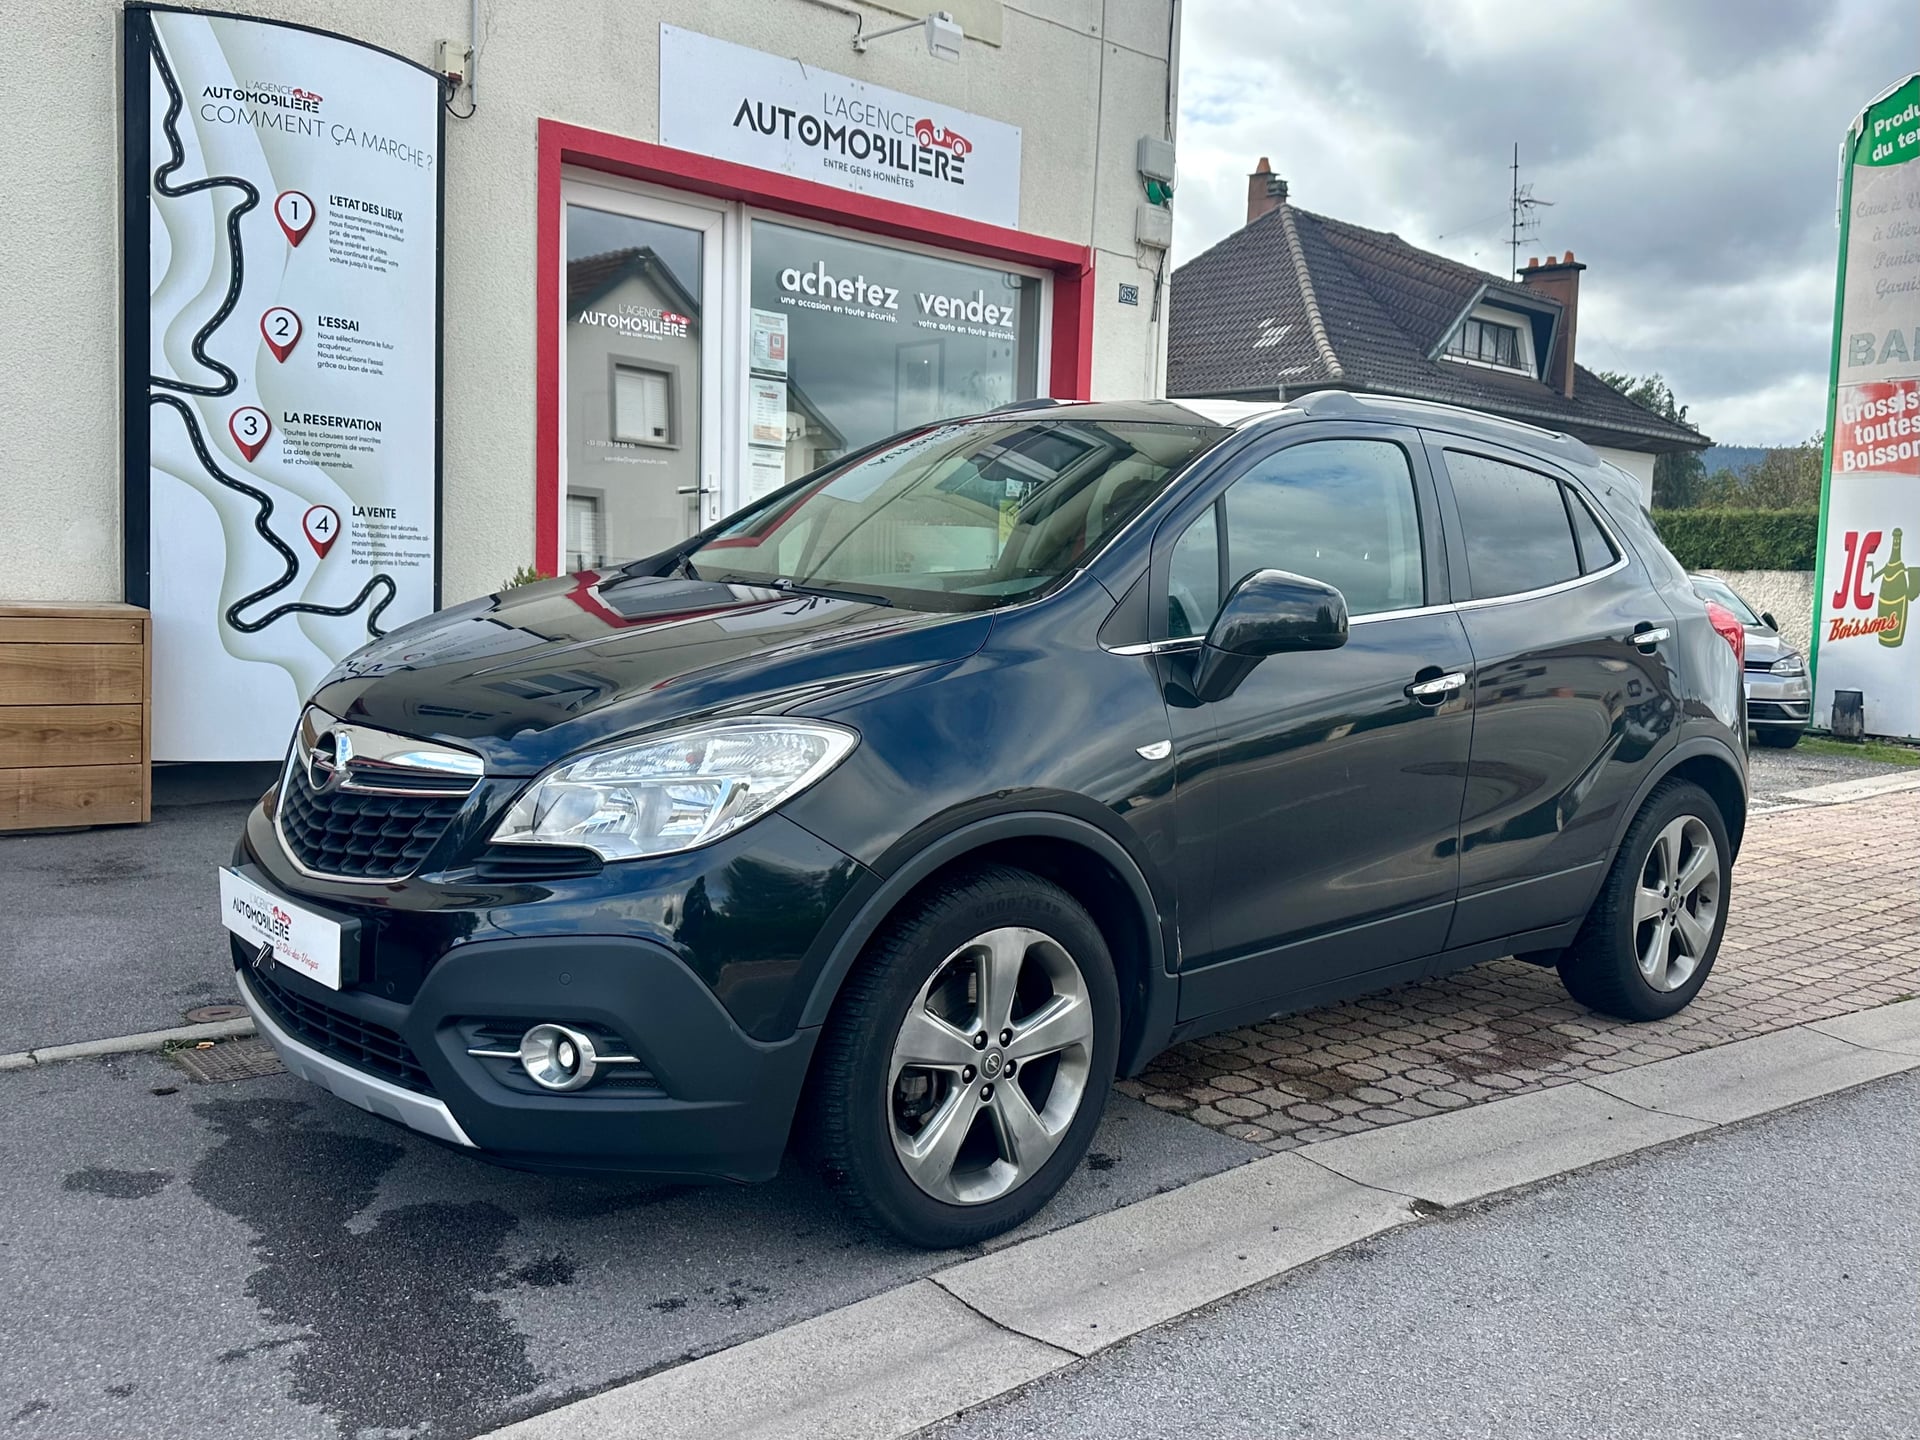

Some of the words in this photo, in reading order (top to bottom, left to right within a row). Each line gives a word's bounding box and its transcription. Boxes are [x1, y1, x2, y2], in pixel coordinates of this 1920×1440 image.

[246, 80, 293, 95] L'AGENCE
[823, 92, 915, 138] L'AGENCE
[201, 104, 325, 136] COMMENT
[330, 124, 357, 146] ÇA
[361, 132, 424, 168] MARCHE
[1872, 142, 1893, 162] du
[823, 159, 848, 173] ENTRE
[850, 165, 871, 178] GENS
[873, 168, 914, 188] HONNÊTES
[291, 201, 298, 220] 1
[329, 211, 343, 219] Nous
[330, 195, 360, 210] L'ETAT
[362, 202, 379, 215] DES
[381, 207, 402, 222] LIEUX
[781, 261, 899, 309] achetez
[1122, 287, 1137, 302] 652
[619, 304, 662, 319] L'AGENCE
[781, 296, 795, 306] une
[798, 299, 830, 311] occasion
[833, 305, 843, 313] en
[845, 305, 864, 318] toute
[867, 309, 897, 323] sécurité.
[919, 289, 1013, 327] vendez
[275, 316, 289, 336] 2
[318, 316, 359, 331] L'ESSAI
[919, 320, 936, 331] votre
[939, 322, 954, 332] auto
[957, 326, 965, 334] en
[968, 327, 985, 337] toute
[988, 329, 1016, 341] sérénité.
[318, 332, 334, 340] Nous
[318, 351, 334, 359] Nous
[1848, 327, 1920, 367] BA
[1842, 389, 1920, 424] Grossis
[244, 416, 257, 435] 3
[284, 412, 300, 424] LA
[304, 414, 381, 432] RESERVATION
[283, 428, 306, 436] Toutes
[319, 432, 343, 440] clauses
[294, 448, 310, 456] date
[311, 442, 347, 450] compromis
[295, 458, 319, 466] choisie
[353, 506, 365, 517] LA
[367, 507, 396, 518] VENTE
[315, 515, 329, 533] 4
[1833, 532, 1882, 610] JC
[1828, 612, 1897, 641] Boissons
